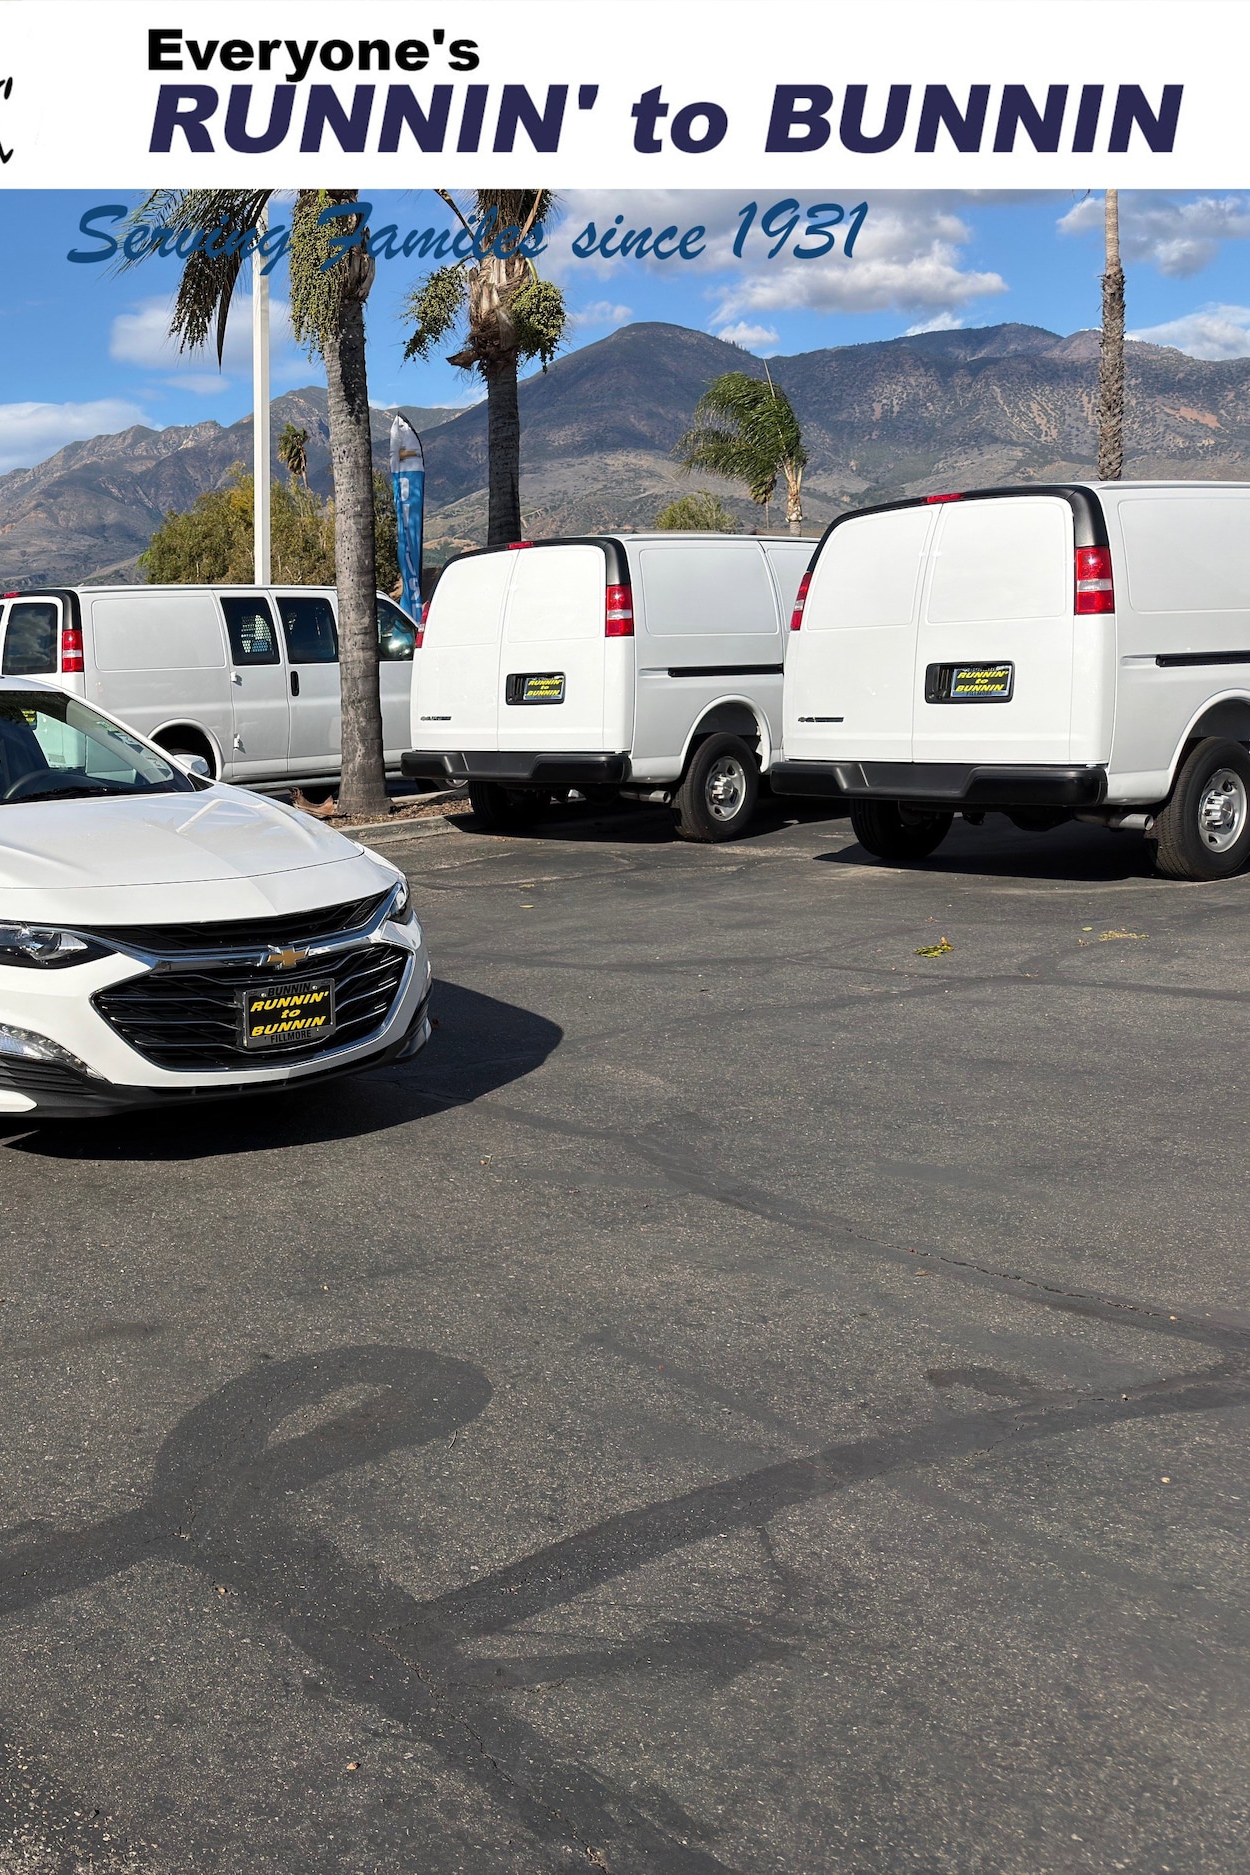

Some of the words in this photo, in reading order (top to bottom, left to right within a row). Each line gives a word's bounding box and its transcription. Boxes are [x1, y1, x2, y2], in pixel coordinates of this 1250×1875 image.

[957, 671, 1009, 679] RUNNIN'
[955, 684, 1004, 692] BUNNIN
[267, 983, 310, 996] BUNNIN
[250, 991, 329, 1012] RUNNIN'
[281, 1009, 301, 1018] to
[251, 1016, 326, 1037] BUNNIN
[270, 1029, 312, 1043] FILLMORE
